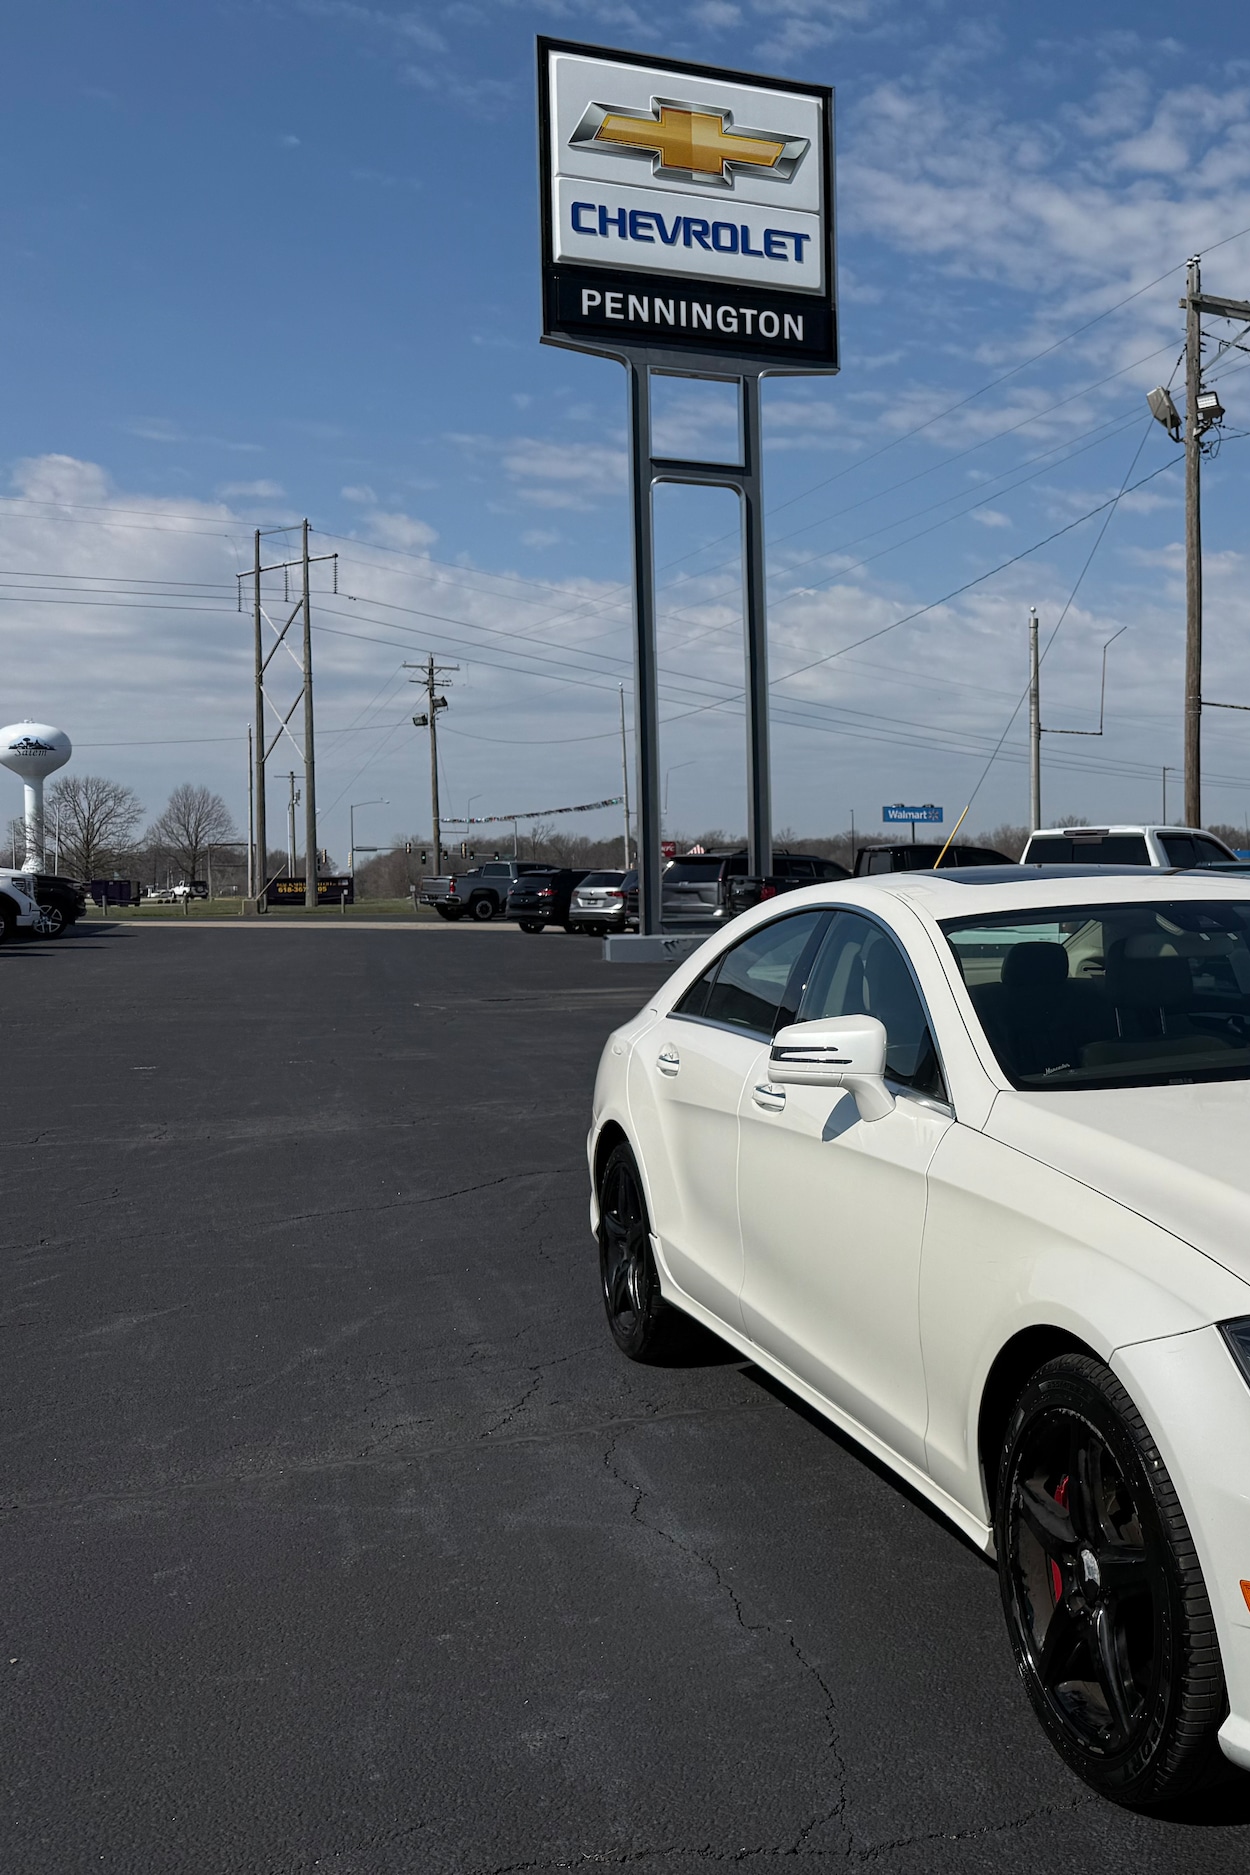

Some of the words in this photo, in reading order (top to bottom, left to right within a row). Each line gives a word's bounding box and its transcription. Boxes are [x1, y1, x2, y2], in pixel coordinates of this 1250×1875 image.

[571, 201, 810, 263] CHEVROLET
[581, 288, 804, 341] PENNINGTON
[14, 747, 48, 757] Salem
[888, 810, 928, 820] Walmart
